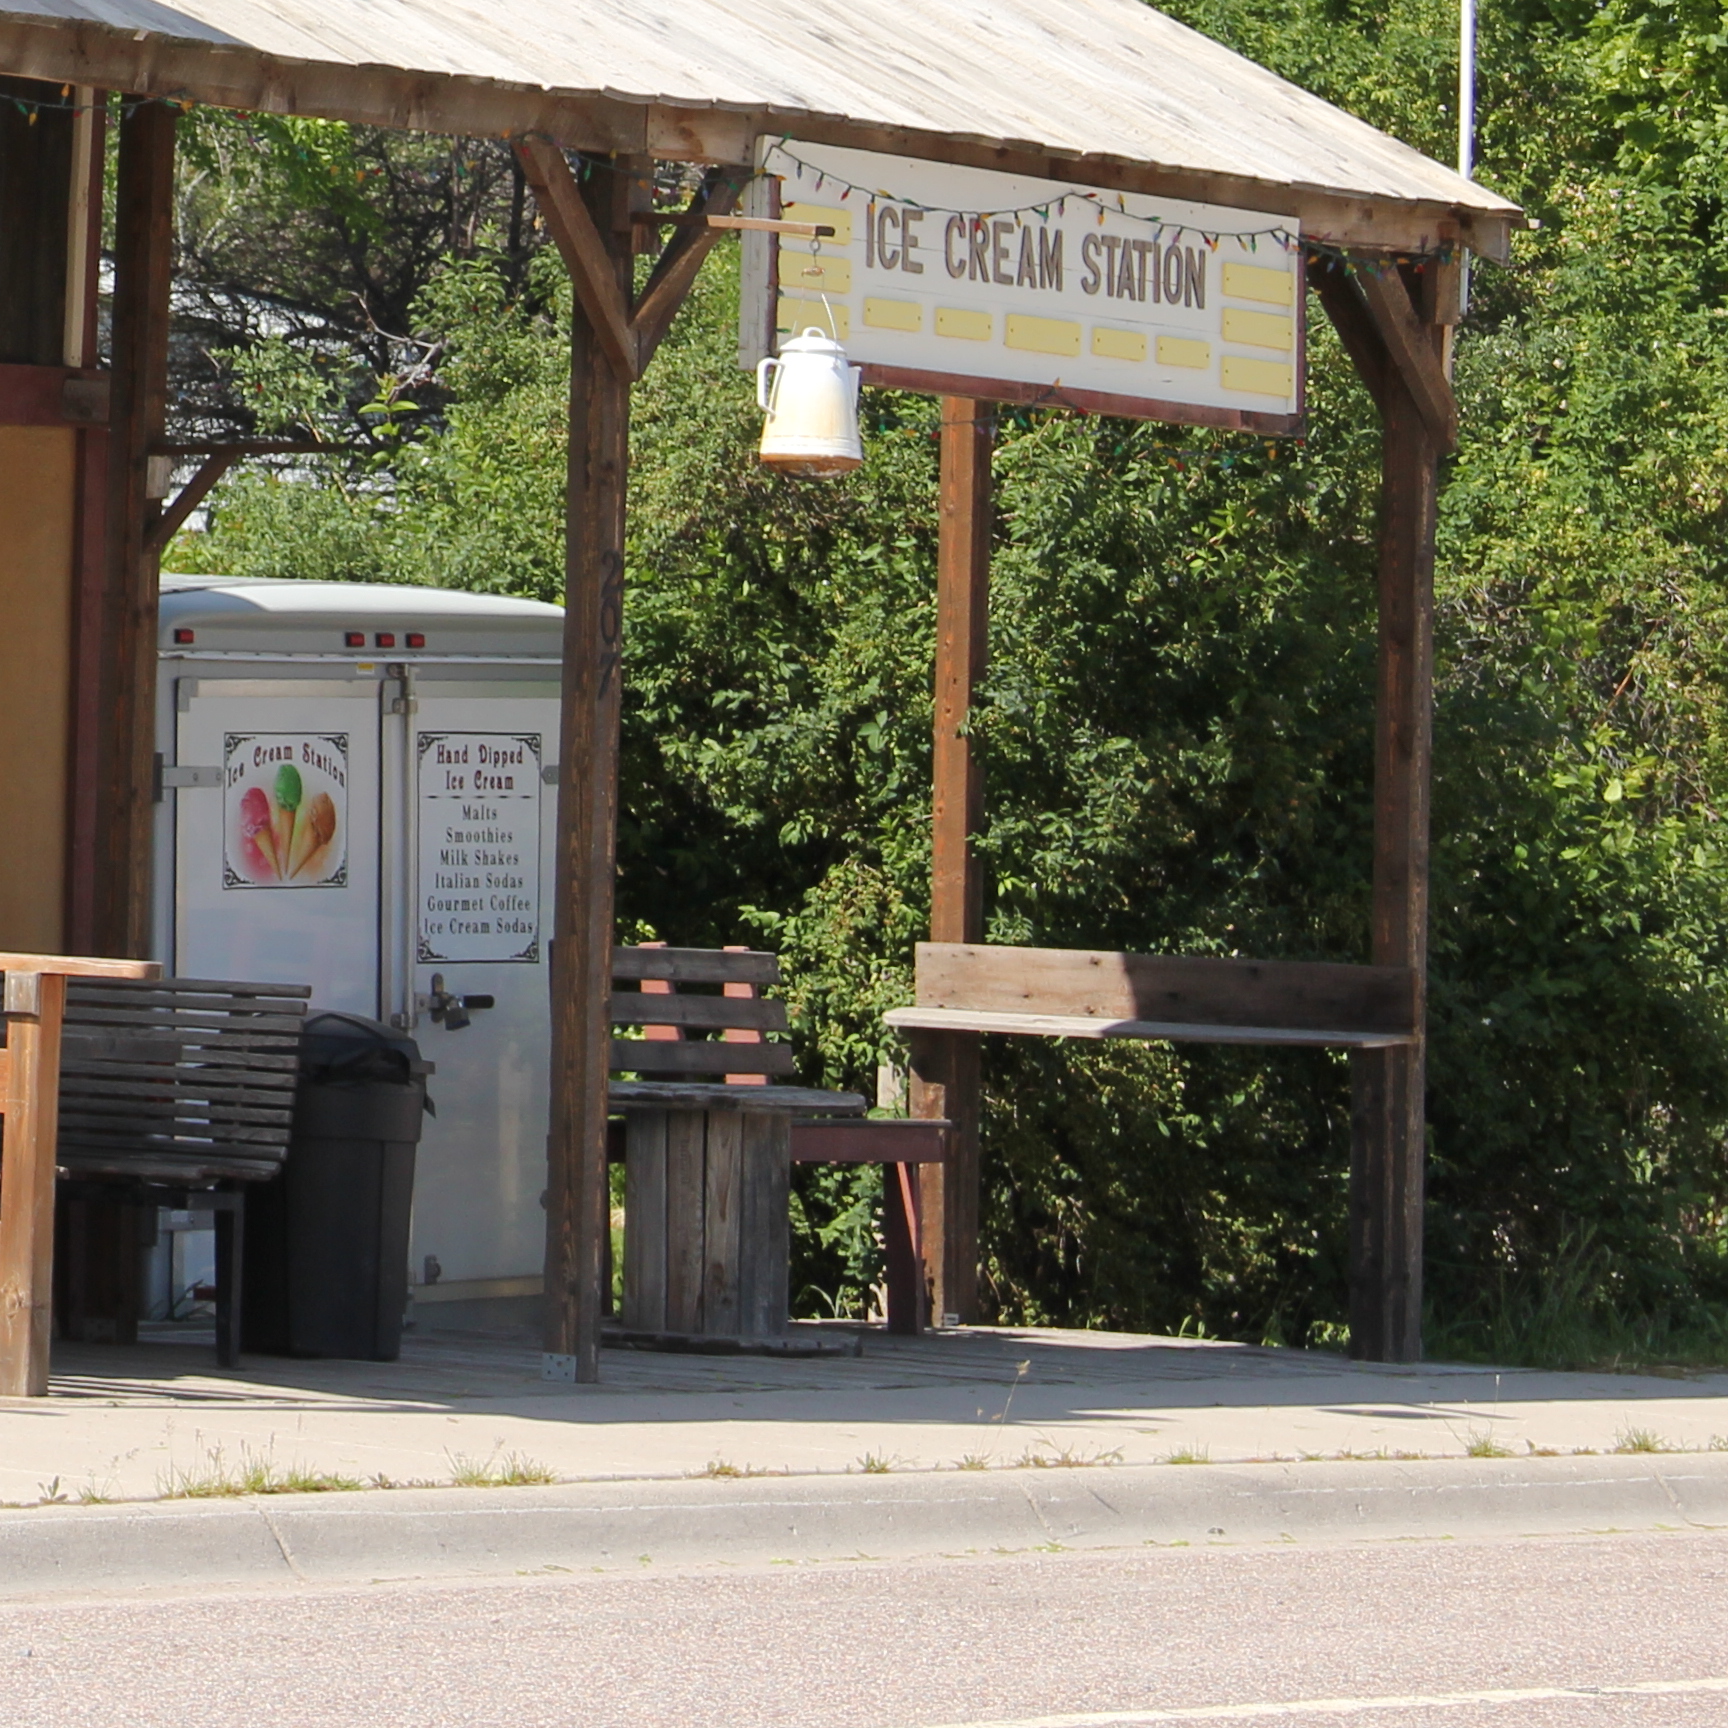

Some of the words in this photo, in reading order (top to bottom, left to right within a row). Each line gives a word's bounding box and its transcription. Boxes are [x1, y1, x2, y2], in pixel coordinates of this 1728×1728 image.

[866, 203, 924, 273] ICE
[945, 215, 1063, 292] CREAM
[1081, 232, 1206, 309] STATION
[436, 744, 468, 764] Hand
[478, 743, 523, 768] Dipped
[227, 762, 244, 788] Ice
[253, 745, 293, 768] Cream
[302, 742, 344, 788] Station
[446, 770, 464, 790] Ice
[474, 770, 513, 790] Cream
[462, 804, 497, 820] Malts
[446, 826, 513, 843] Smoothies
[440, 849, 468, 866] Milk
[474, 849, 519, 866] Shakes
[435, 872, 479, 889] Italian
[486, 872, 523, 889] Sodas
[427, 895, 484, 911] Gourmet
[490, 894, 531, 911] Coffee
[424, 918, 443, 934] Ice
[449, 917, 490, 934] Cream
[496, 917, 533, 934] Sodas
